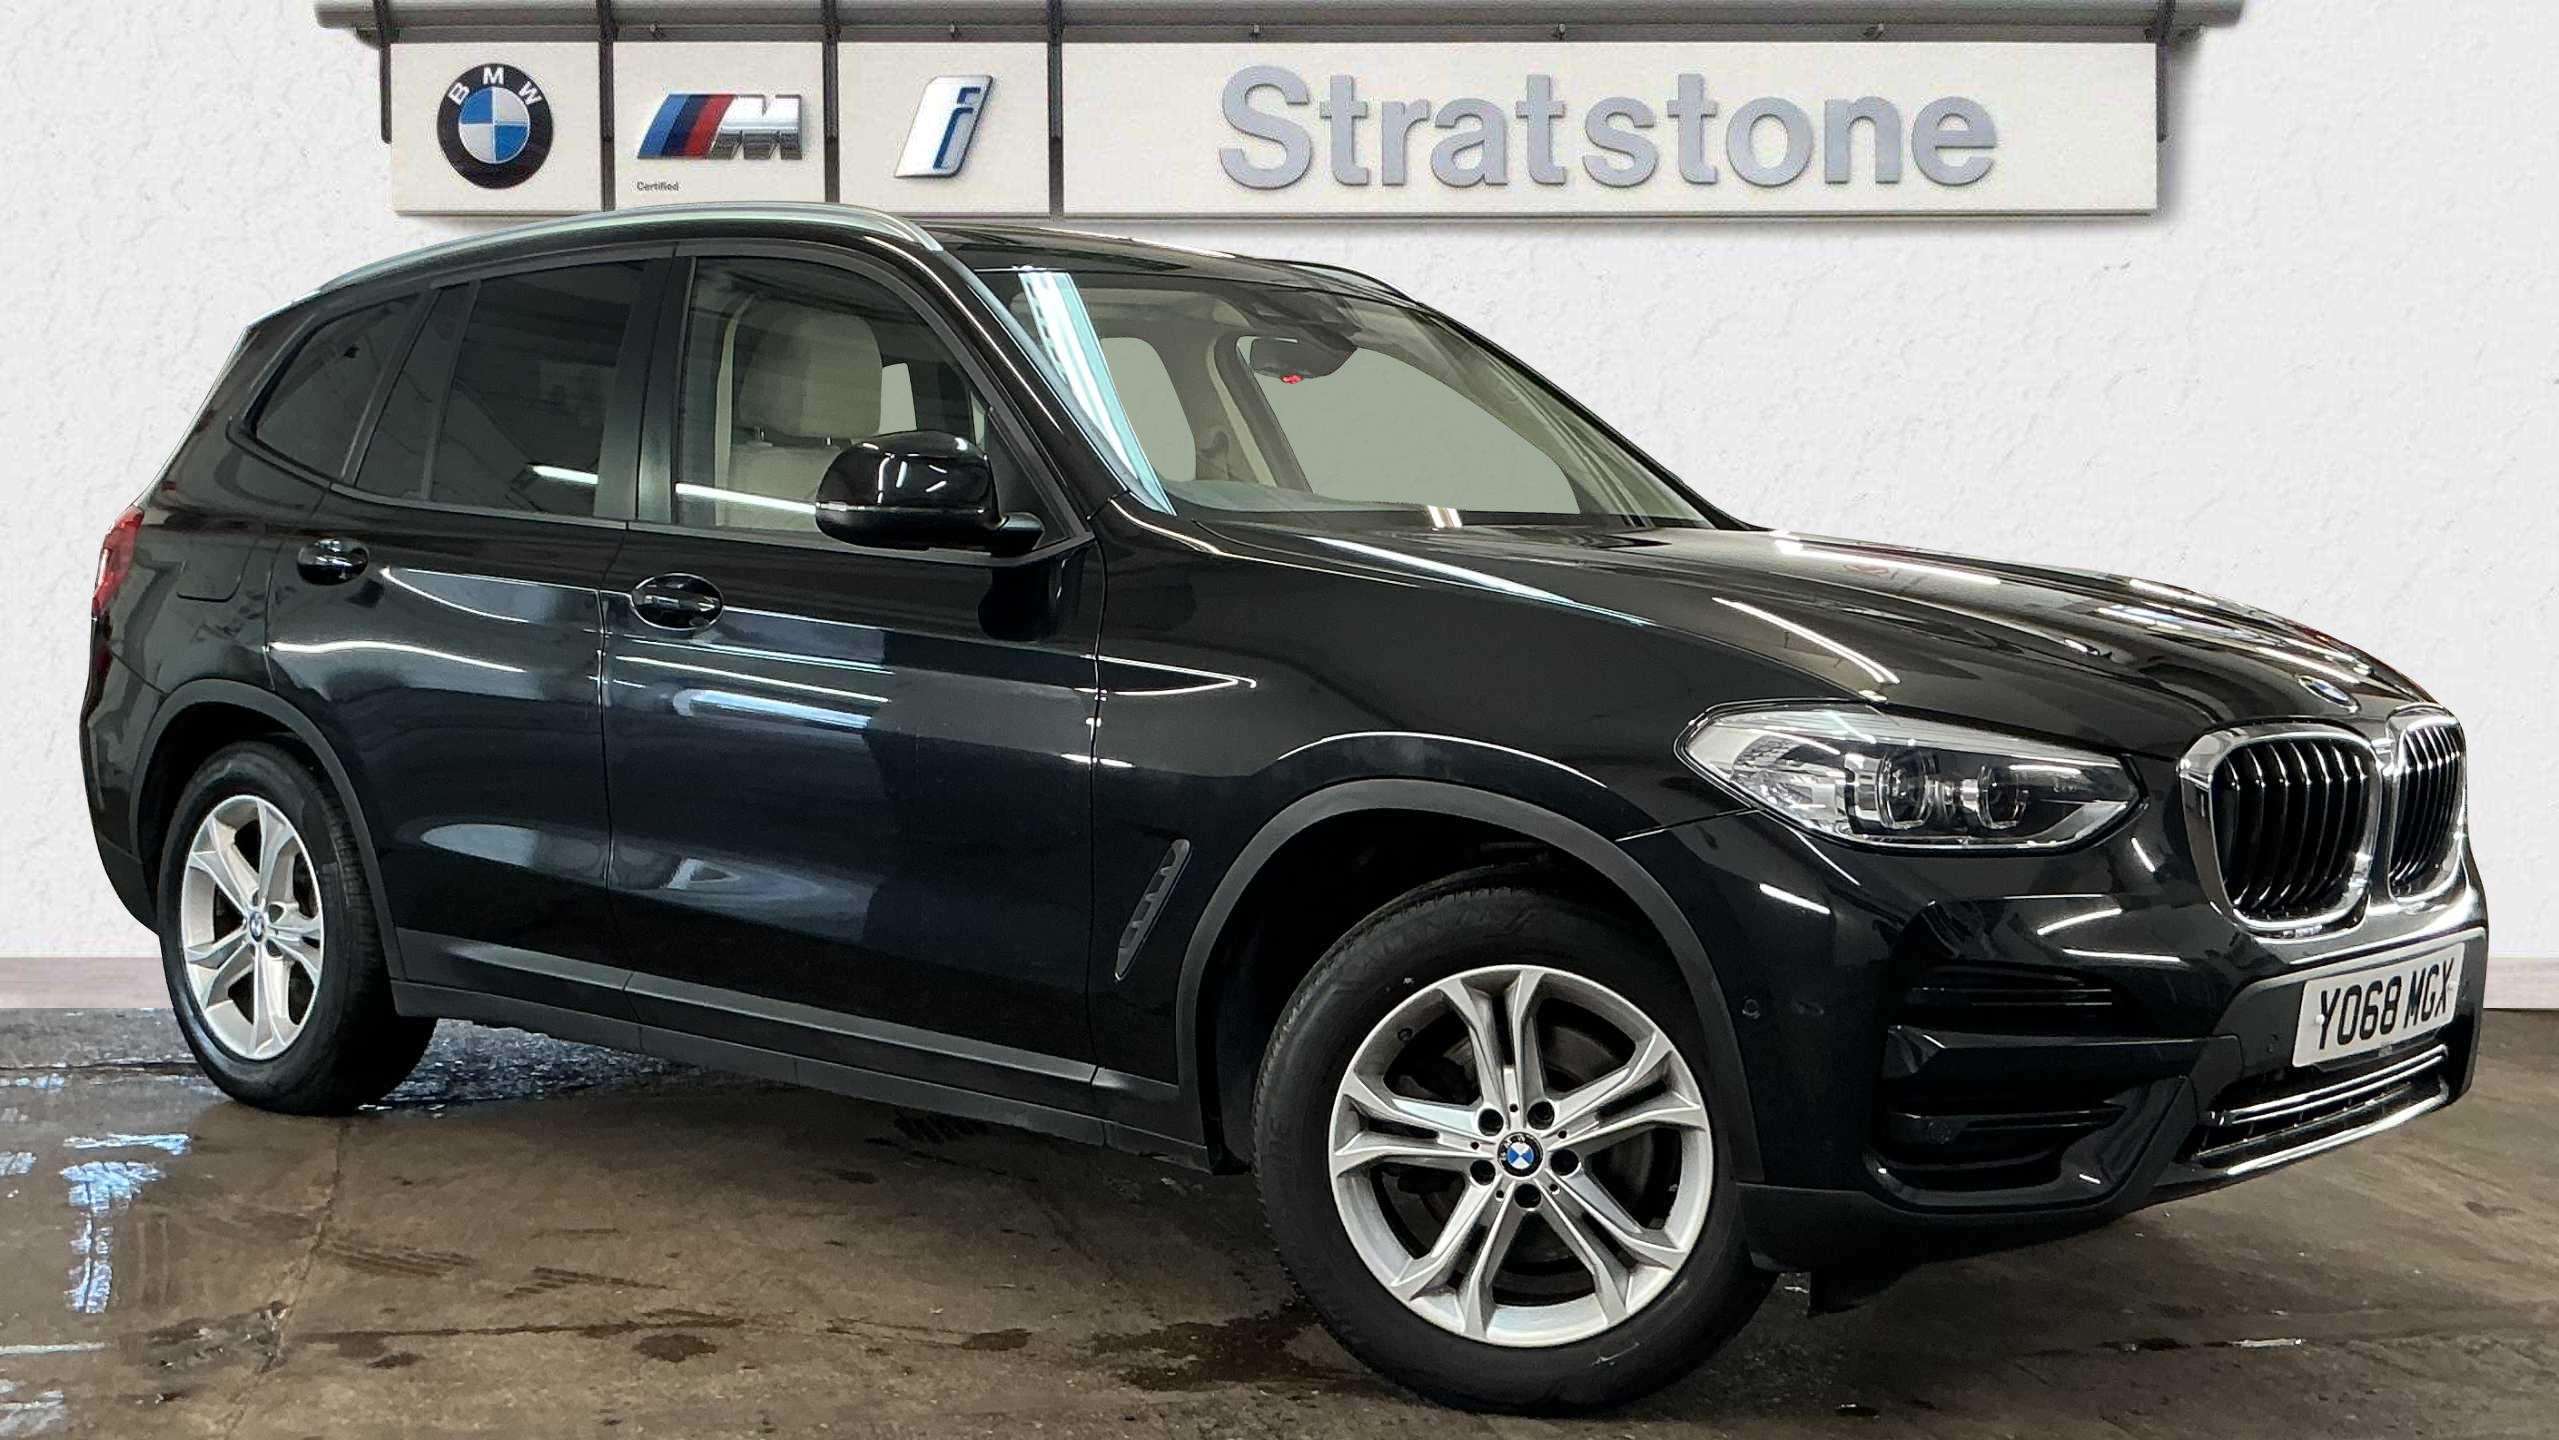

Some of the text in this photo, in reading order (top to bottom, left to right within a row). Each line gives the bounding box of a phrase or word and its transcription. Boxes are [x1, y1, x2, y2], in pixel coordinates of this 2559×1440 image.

[448, 66, 543, 106] BMW
[1218, 65, 1998, 189] Stratstone
[636, 181, 680, 192] Certified
[2318, 957, 2455, 1051] YO68 MGX
